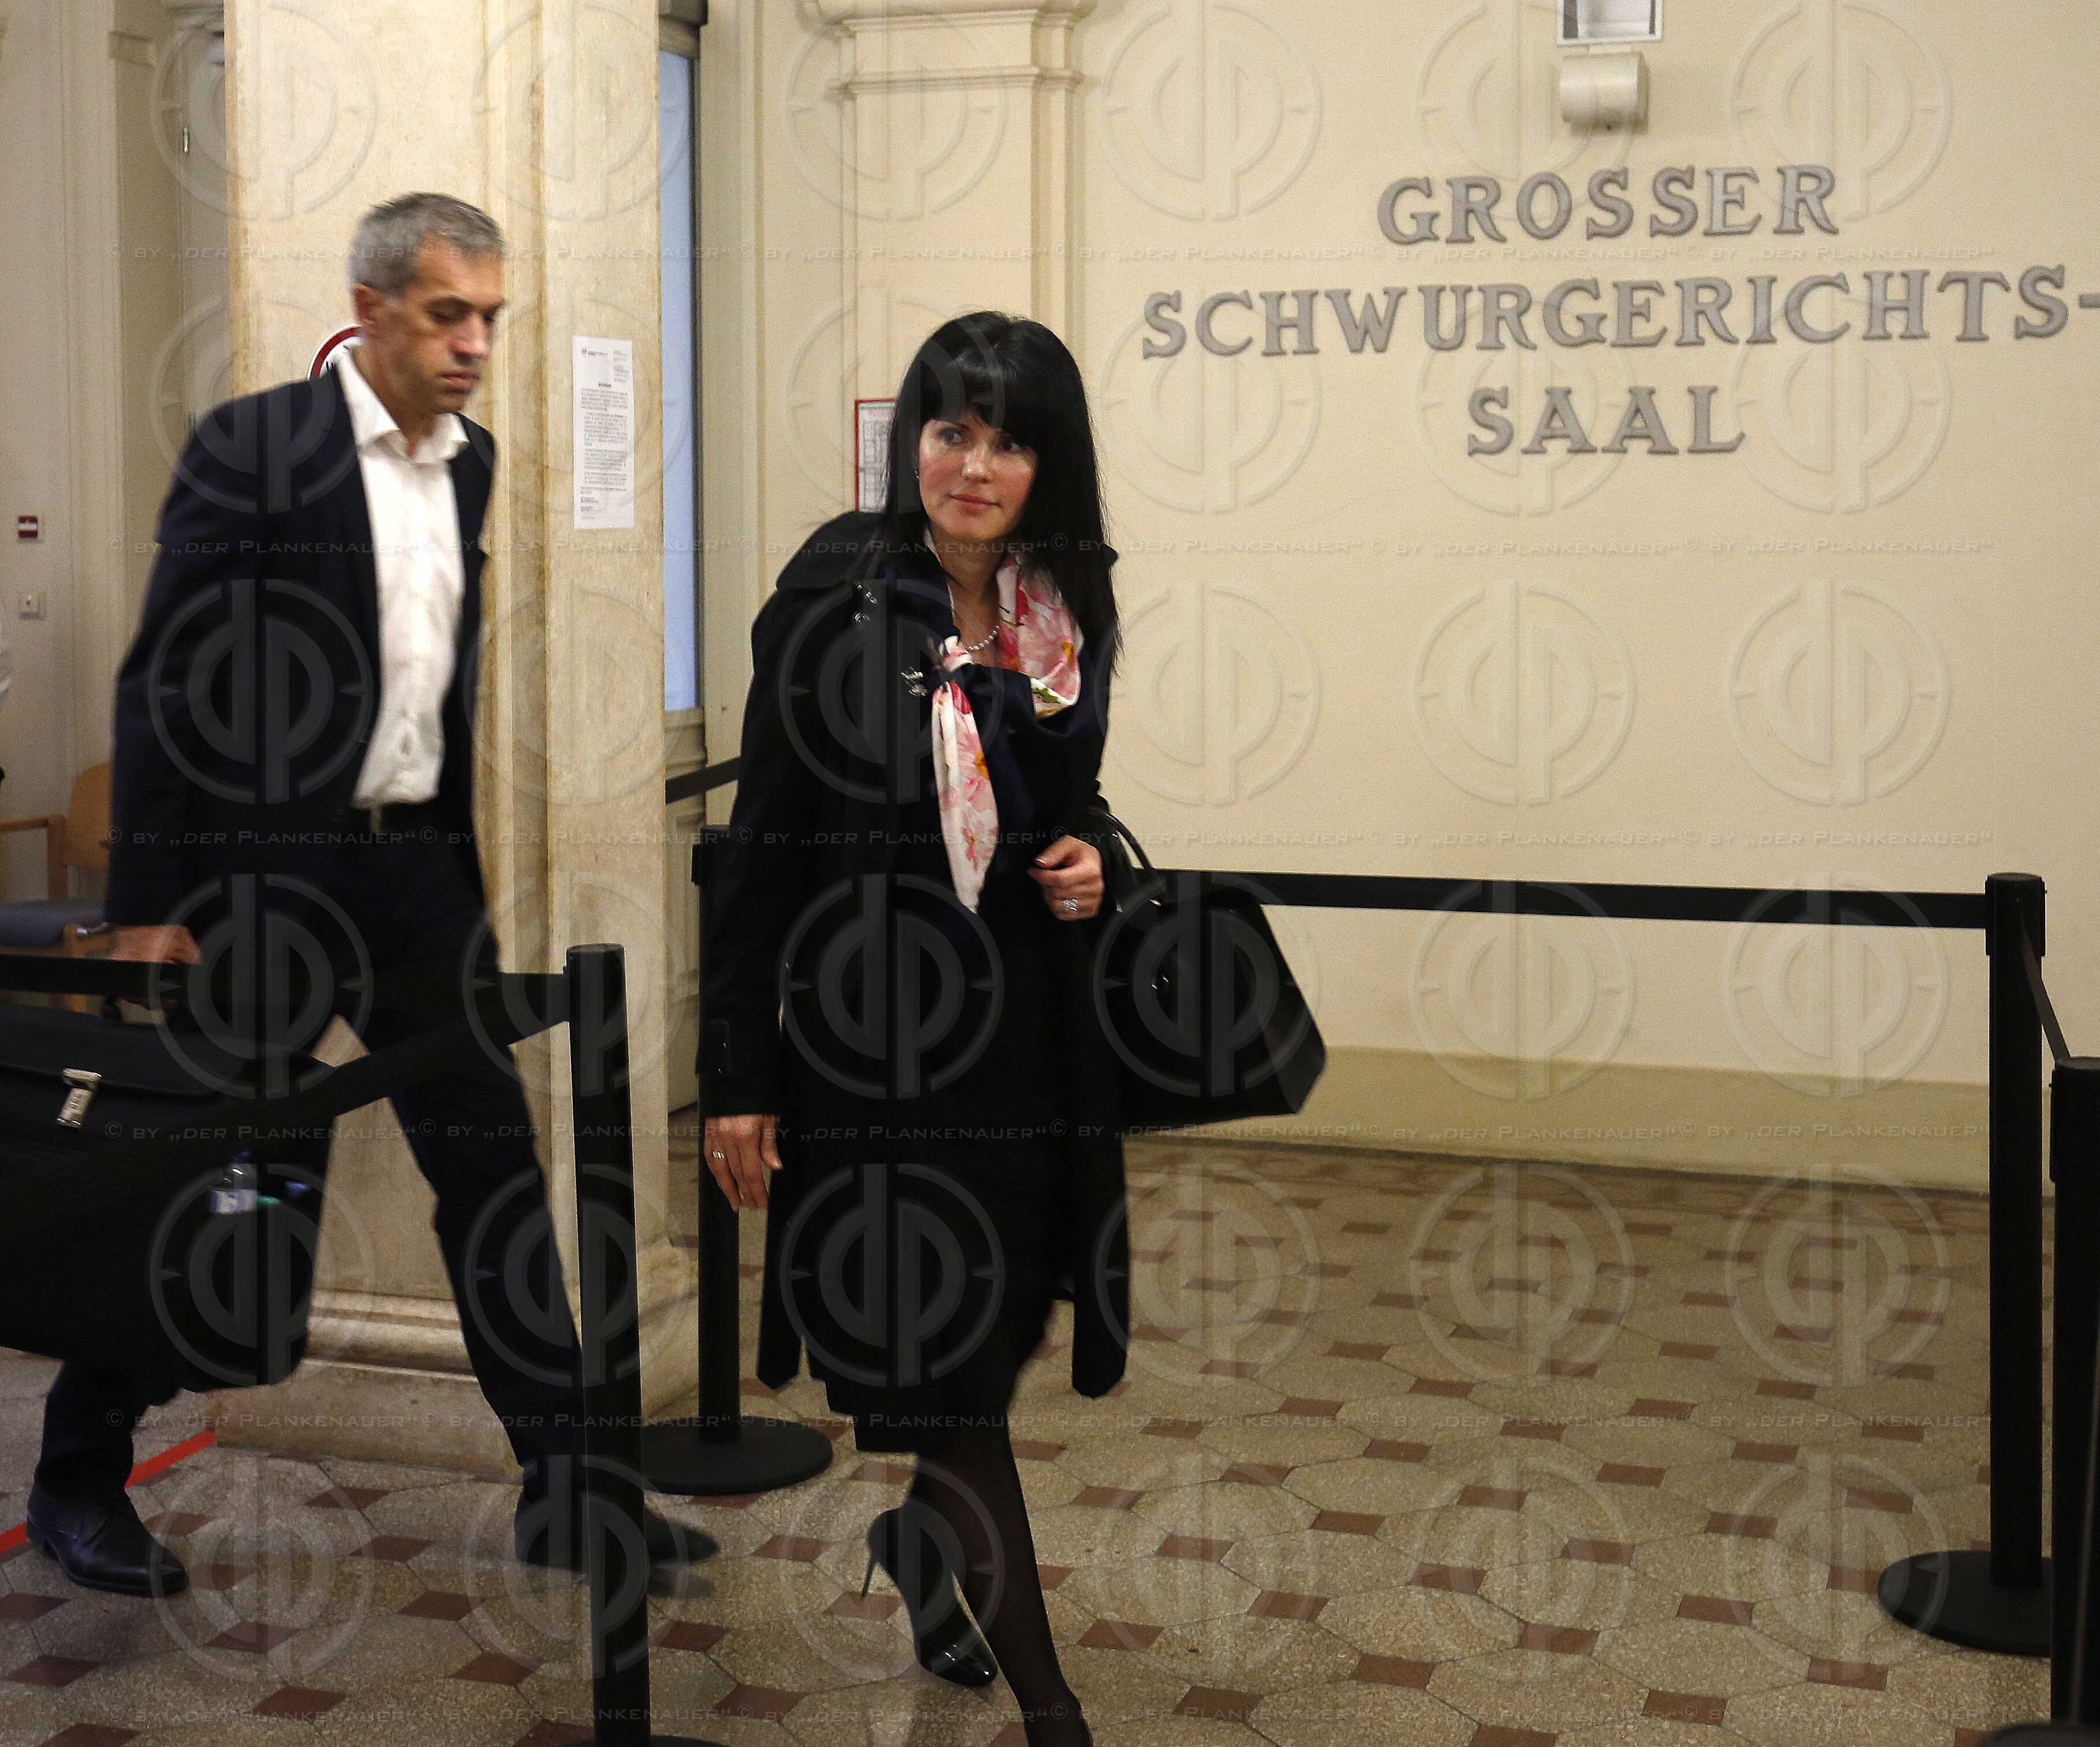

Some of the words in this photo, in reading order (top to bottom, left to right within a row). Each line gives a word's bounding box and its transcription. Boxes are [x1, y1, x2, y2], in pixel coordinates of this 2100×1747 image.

[1378, 164, 1839, 246] GROSSER
[1143, 264, 2100, 359] SCHWURGERICHTS-
[1467, 387, 1745, 457] SAAL
